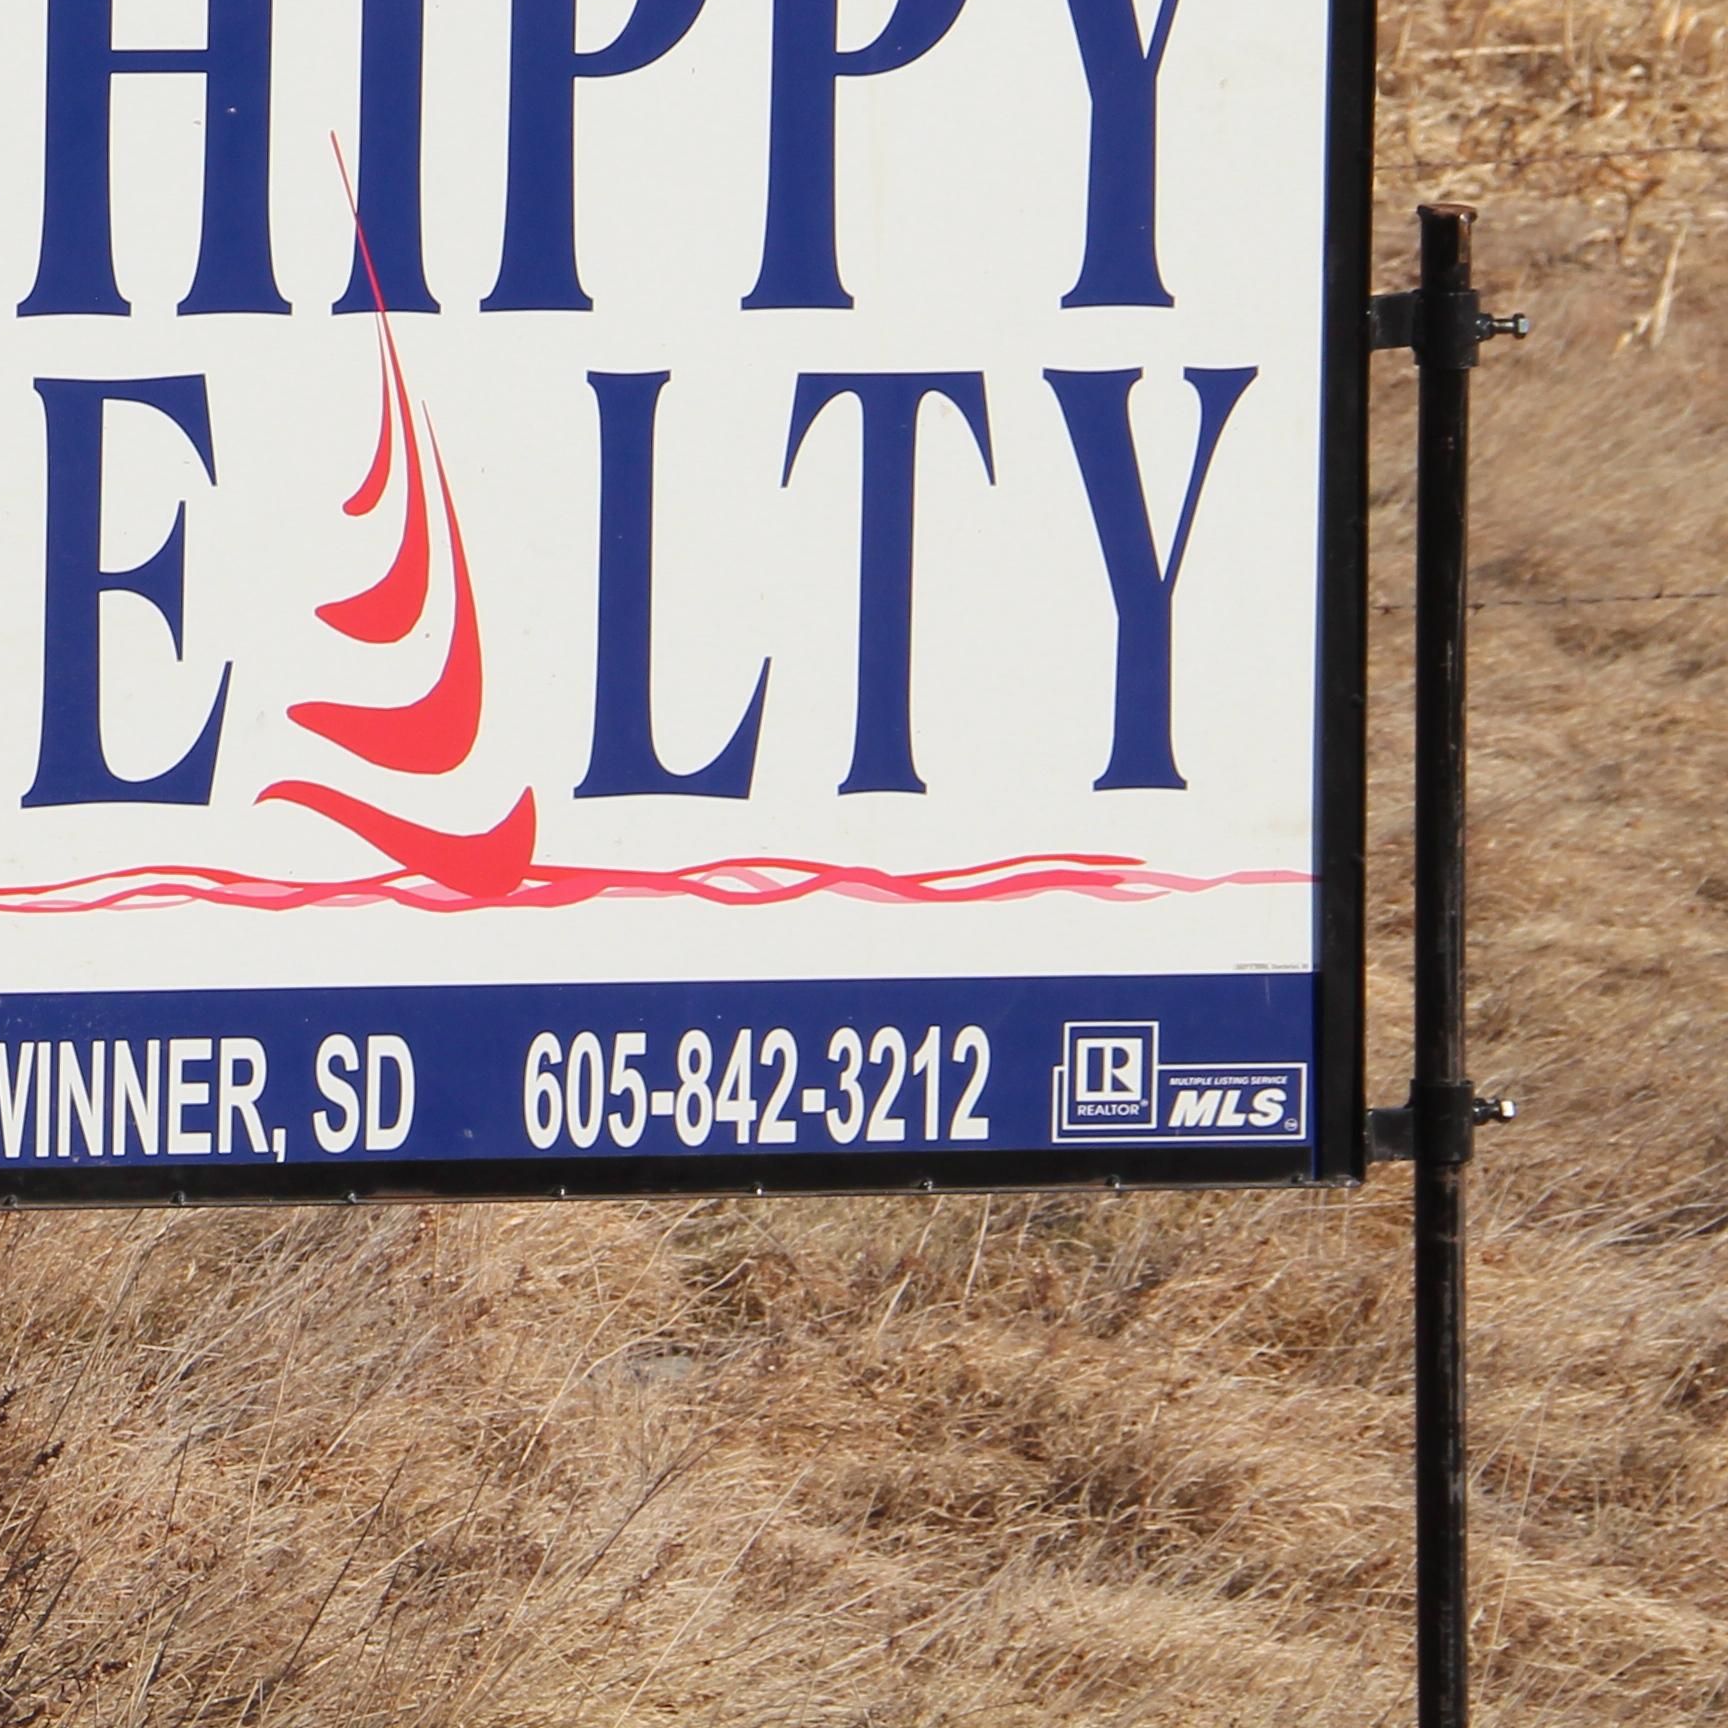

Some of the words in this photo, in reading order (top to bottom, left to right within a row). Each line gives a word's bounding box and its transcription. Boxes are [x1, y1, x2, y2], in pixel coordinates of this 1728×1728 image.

[313, 1033, 416, 1154] SD
[523, 1024, 991, 1149] 605-842-3212
[1167, 1088, 1287, 1127] MLS
[1169, 1076, 1212, 1086] MULTIPLE
[1214, 1076, 1248, 1086] LISTING
[1250, 1075, 1288, 1085] SERVICE
